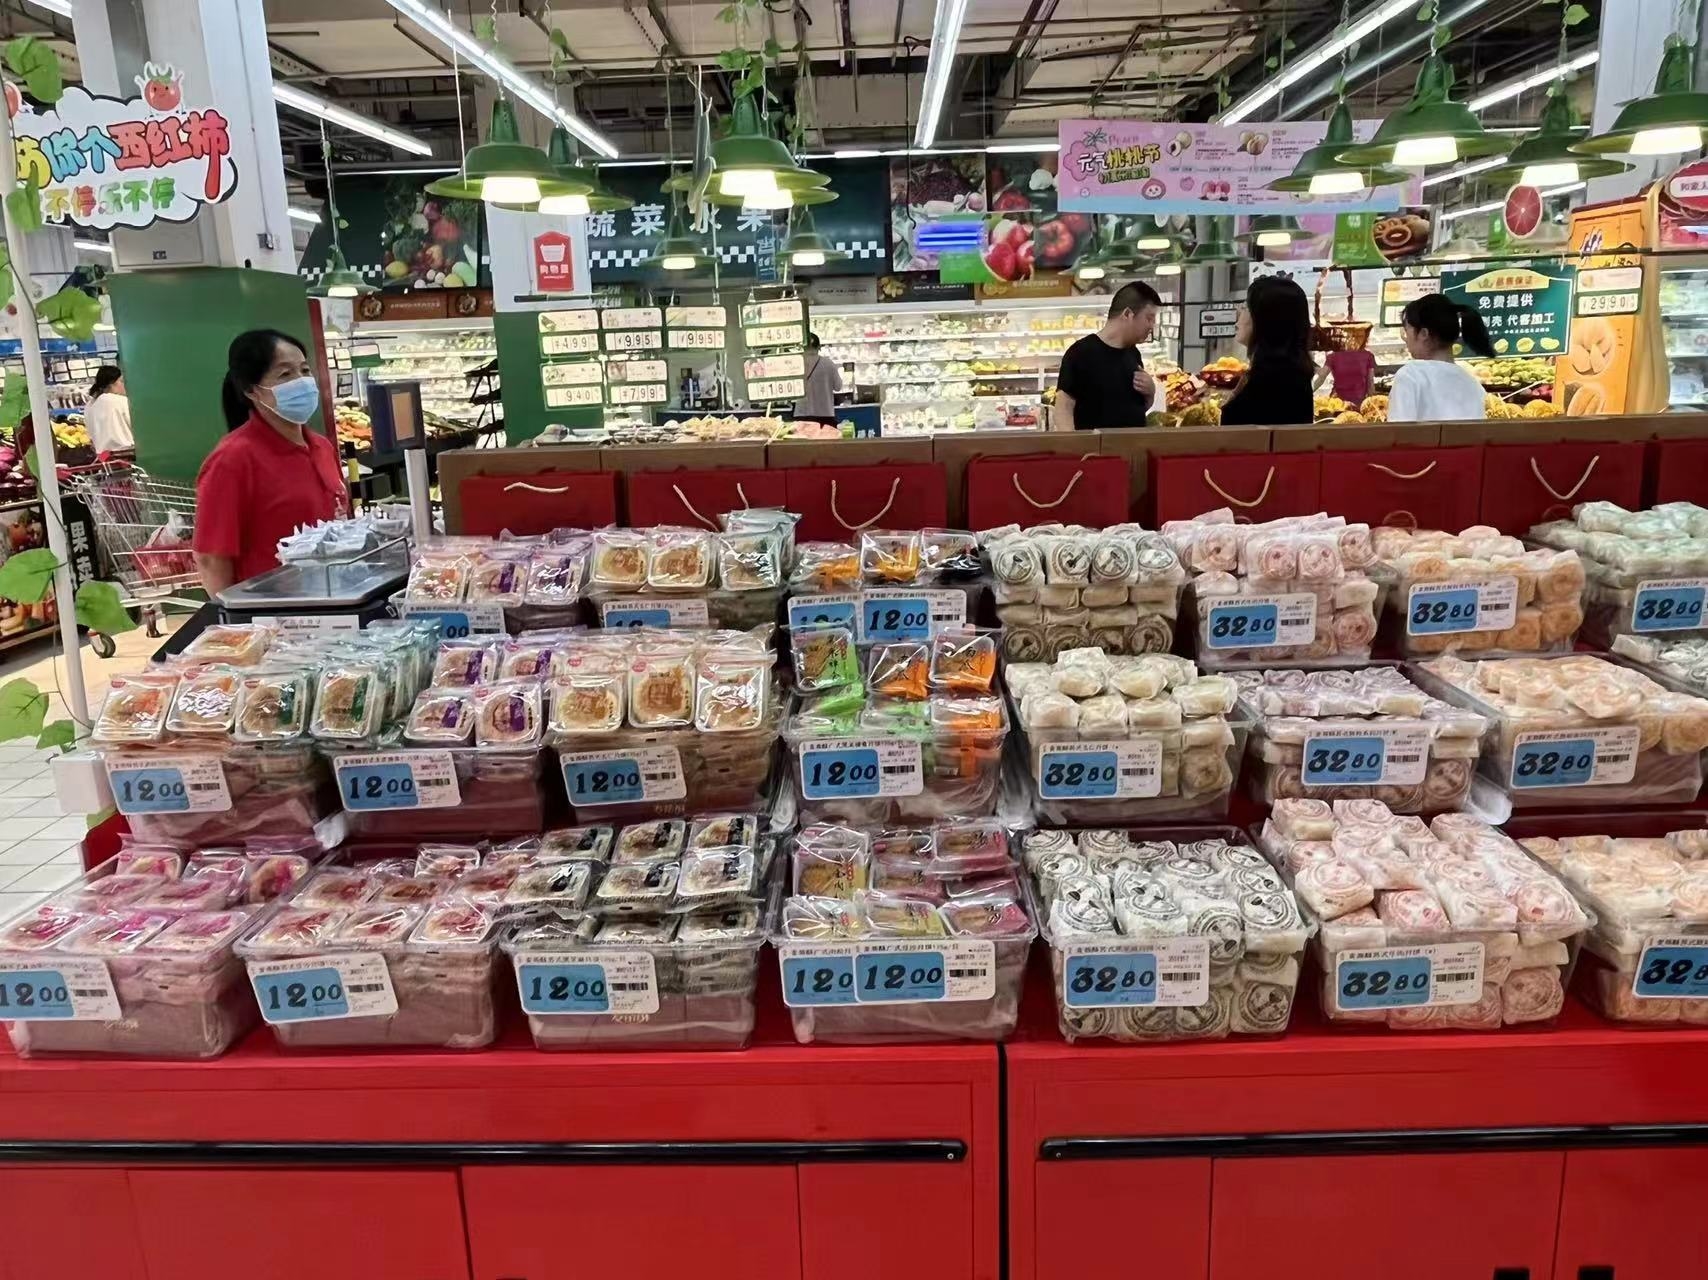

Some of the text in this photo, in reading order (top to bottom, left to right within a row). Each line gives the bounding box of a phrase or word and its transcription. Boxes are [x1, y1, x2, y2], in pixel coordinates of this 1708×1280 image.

[1077, 143, 1161, 173] 元气桃桃节
[1478, 293, 1533, 309] 免费提供
[1507, 312, 1555, 326] 代客加工
